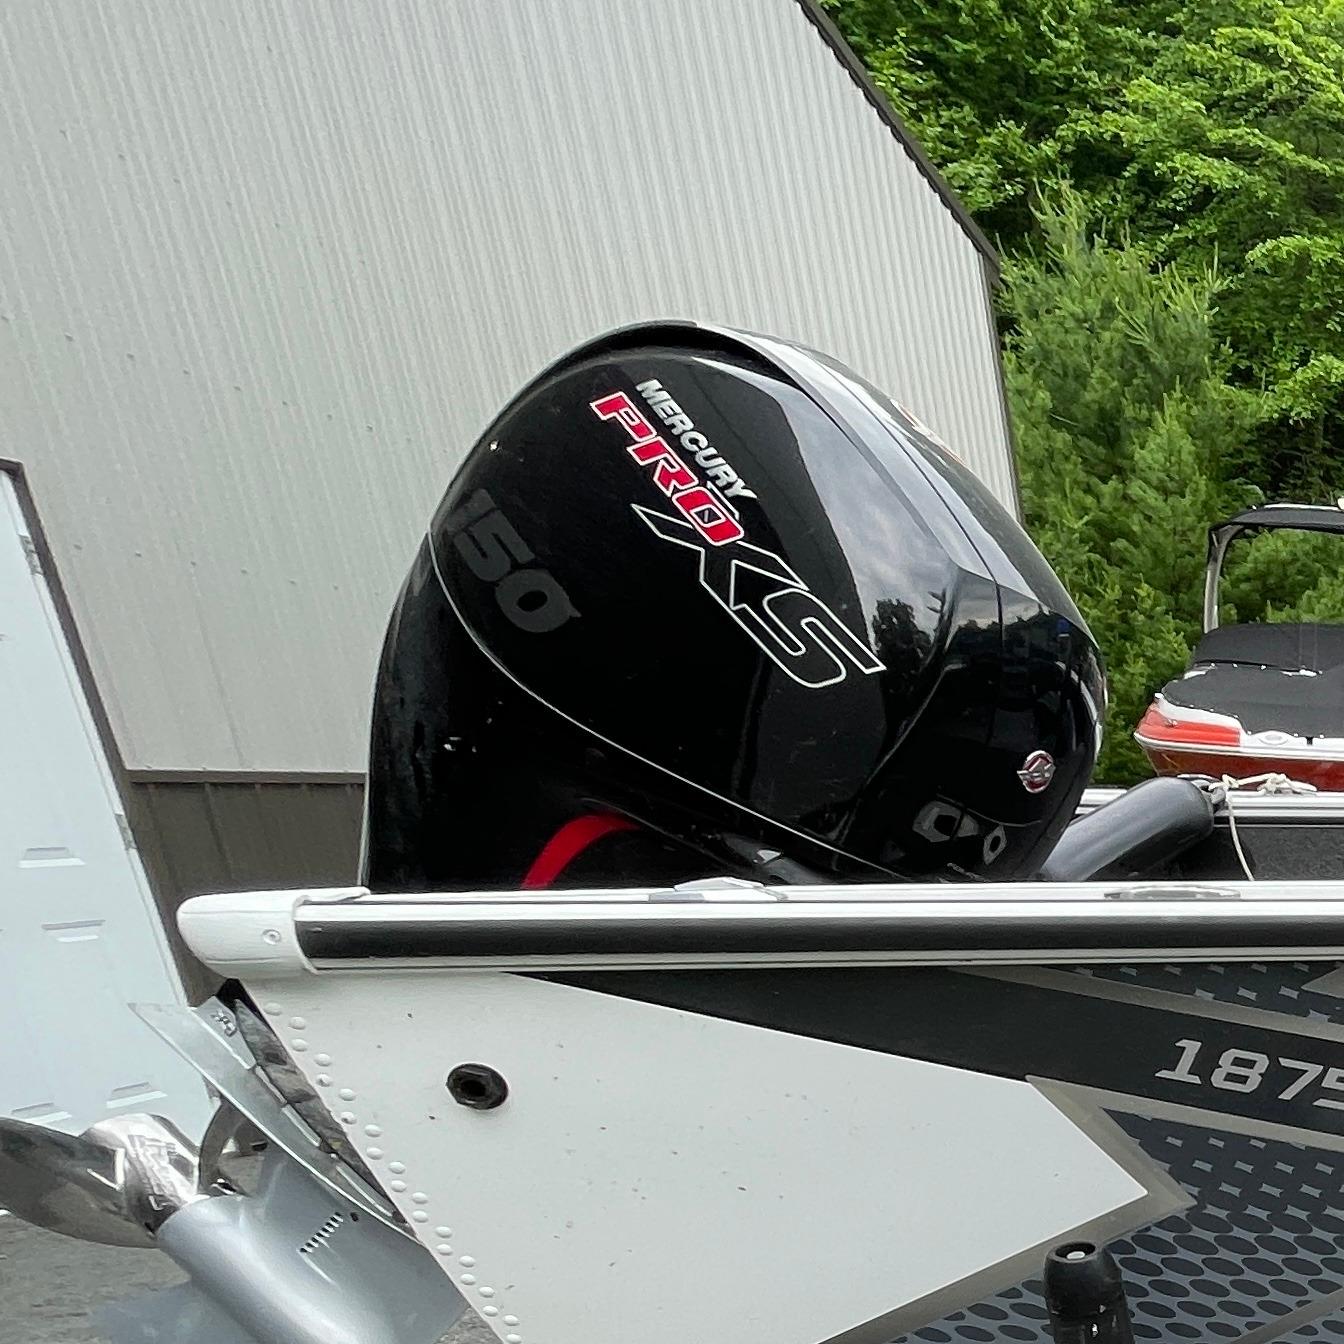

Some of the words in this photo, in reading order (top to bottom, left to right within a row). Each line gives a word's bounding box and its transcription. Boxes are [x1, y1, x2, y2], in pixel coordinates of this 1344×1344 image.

[589, 390, 745, 547] PRO
[634, 378, 758, 499] MERCURY
[446, 487, 582, 634] 150
[630, 502, 888, 689] XS
